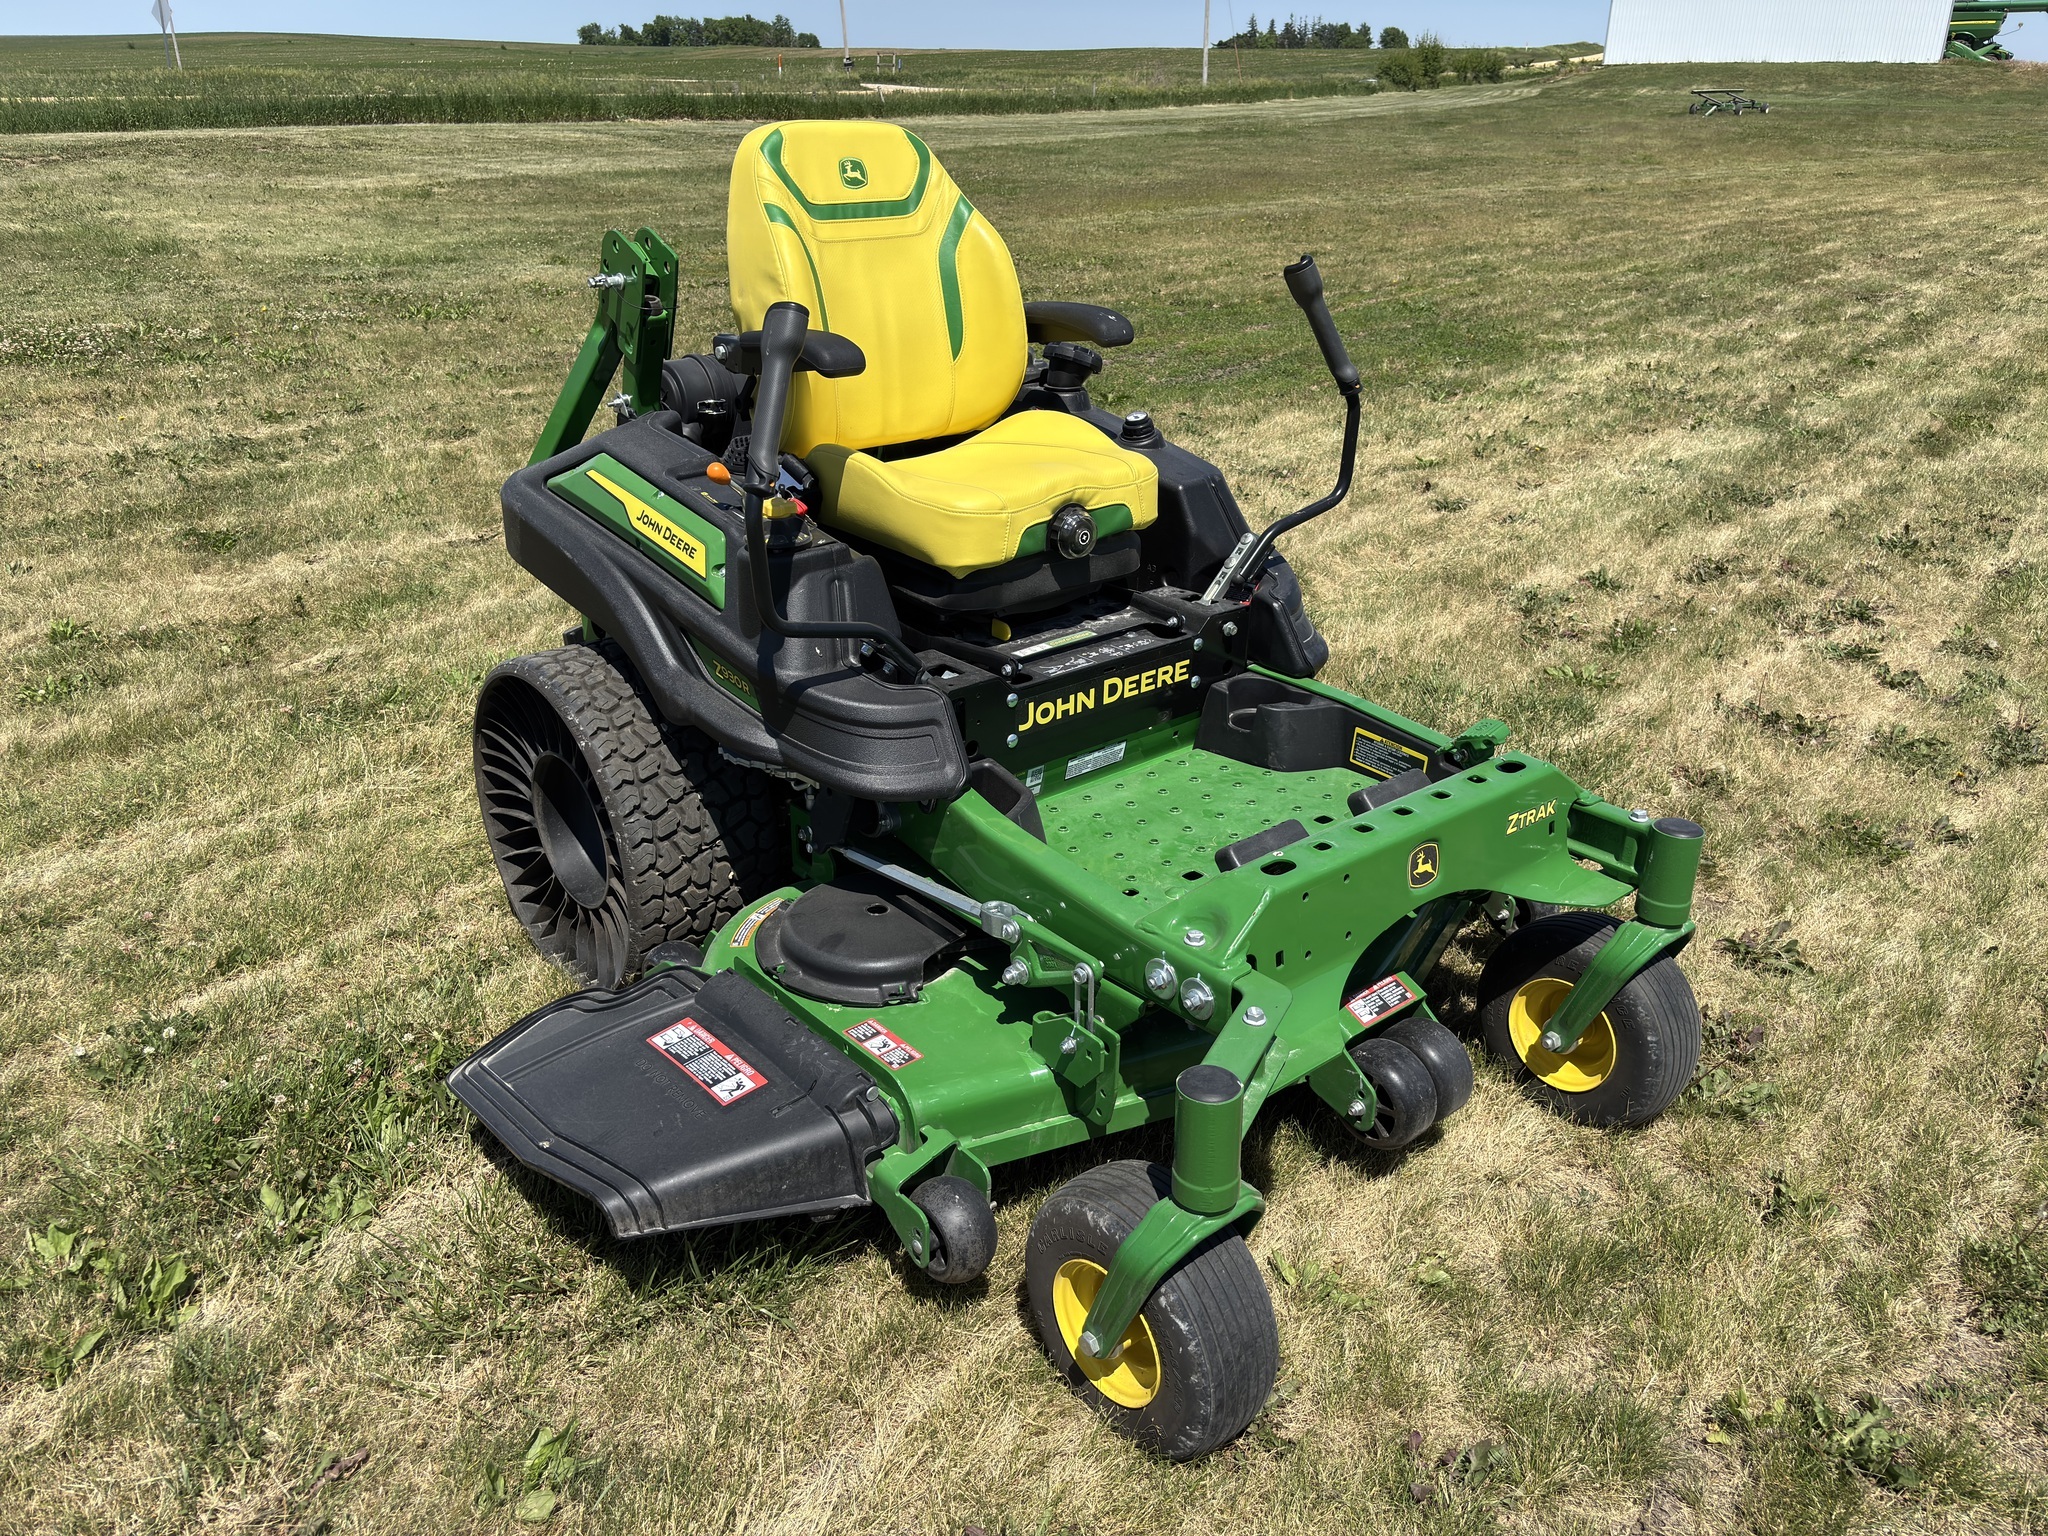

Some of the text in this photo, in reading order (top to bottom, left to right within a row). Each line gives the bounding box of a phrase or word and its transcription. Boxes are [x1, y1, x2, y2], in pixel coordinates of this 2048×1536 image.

[636, 510, 698, 560] JOHN DEERE
[713, 660, 751, 696] Z930R
[1018, 687, 1096, 732] JOHN
[1103, 659, 1191, 705] DEERE
[1506, 799, 1557, 835] ZTRAK
[732, 1056, 755, 1076] PELIGRO
[635, 1058, 707, 1119] DO NOT REMOVE
[1036, 1226, 1109, 1257] CARLISLE
